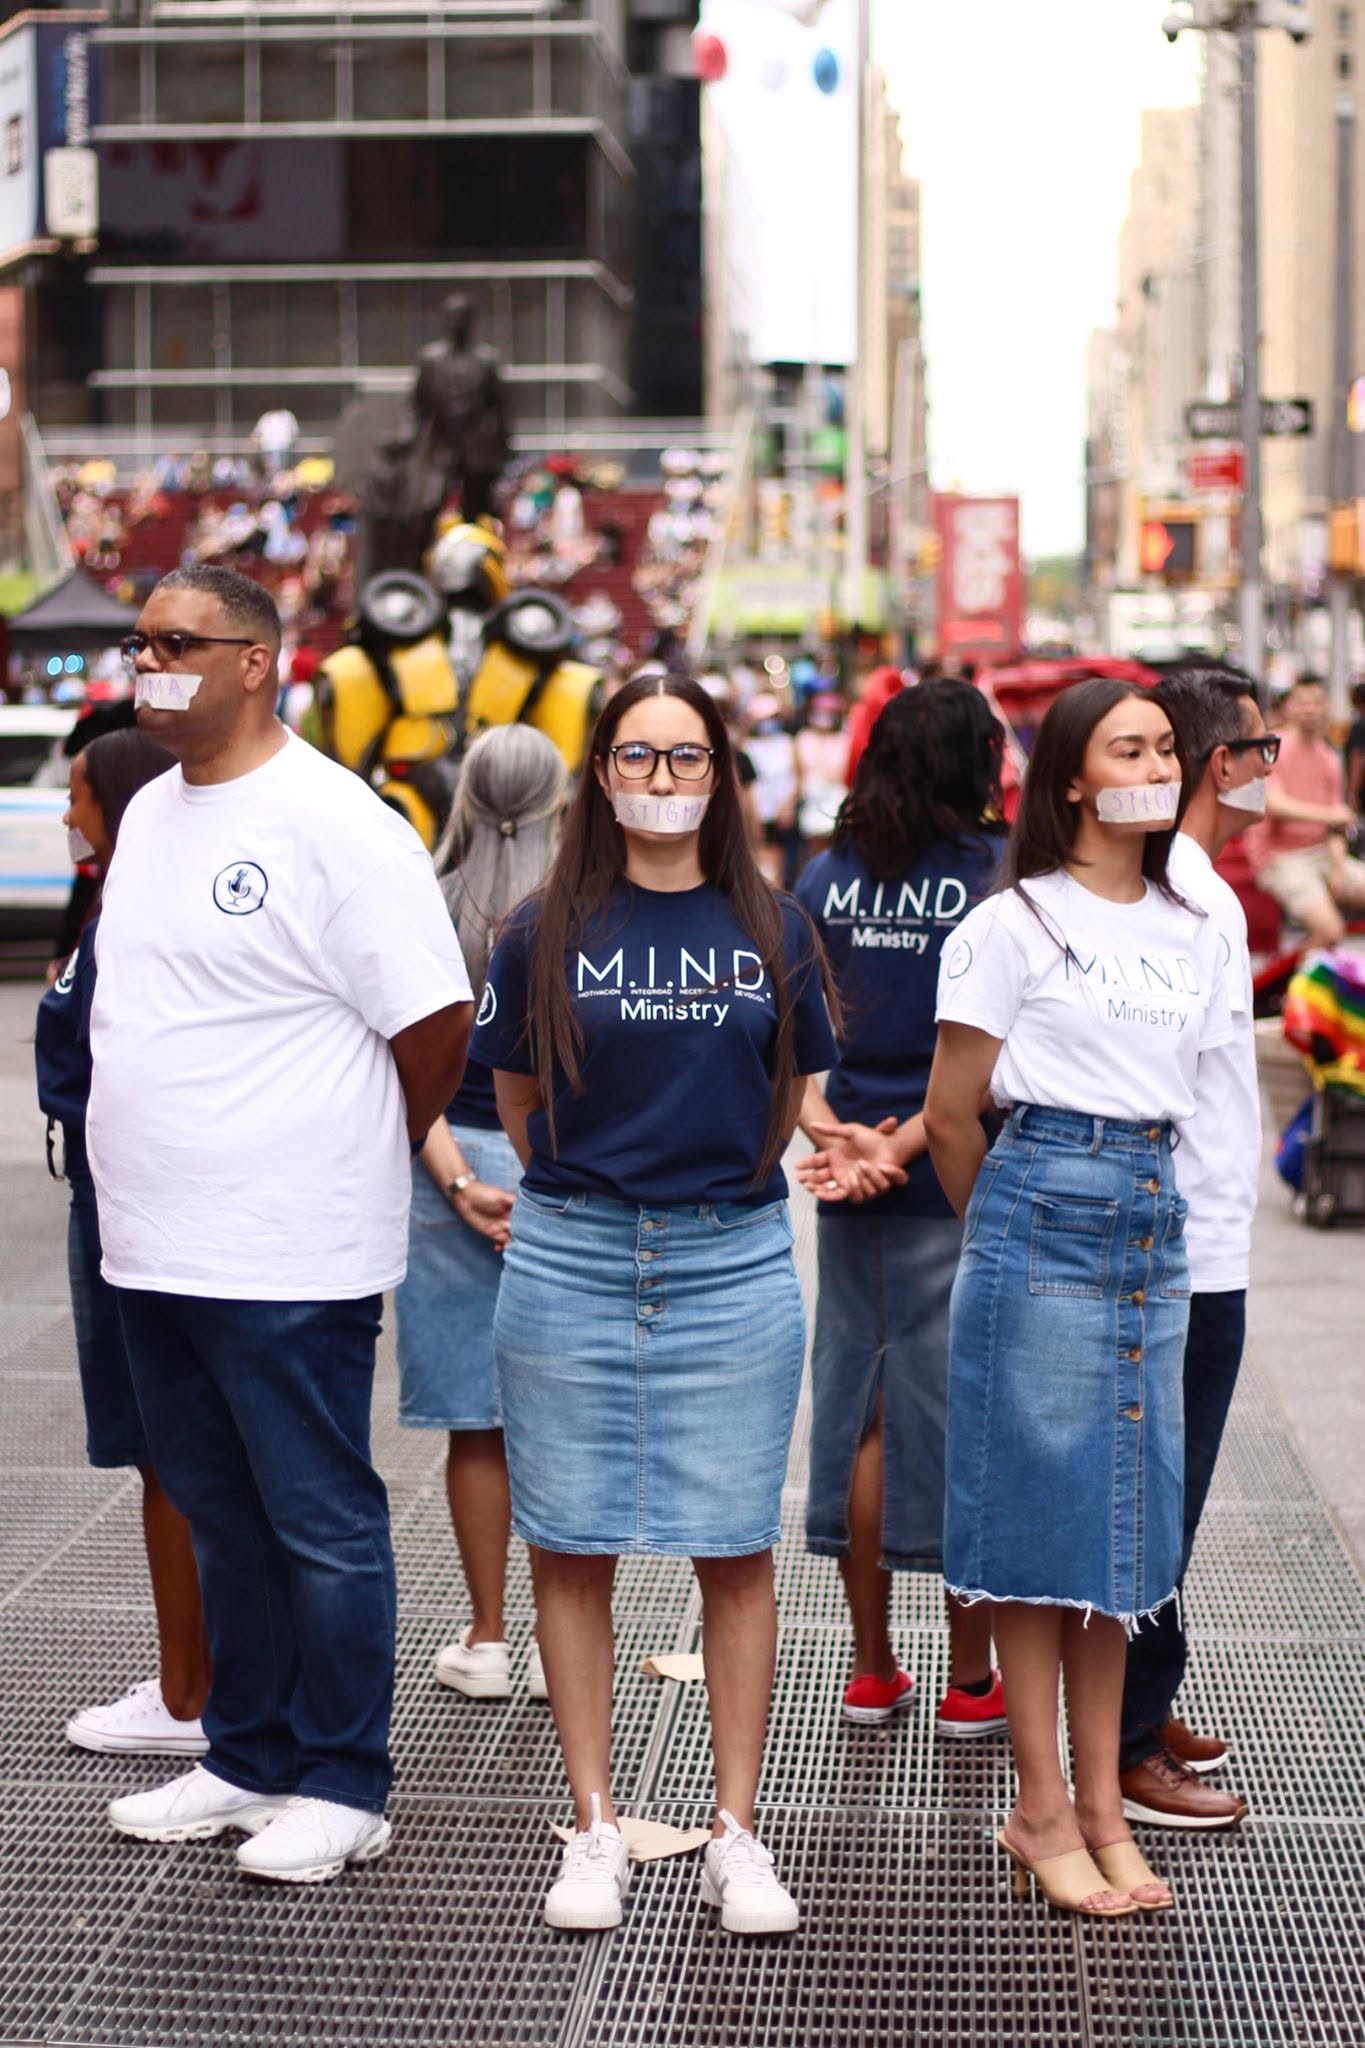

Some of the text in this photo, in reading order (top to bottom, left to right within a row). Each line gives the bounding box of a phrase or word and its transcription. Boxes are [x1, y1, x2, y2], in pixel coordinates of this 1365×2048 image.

[852, 926, 930, 955] Ministry
[620, 998, 730, 1027] Ministry
[1107, 999, 1188, 1033] Ministry
